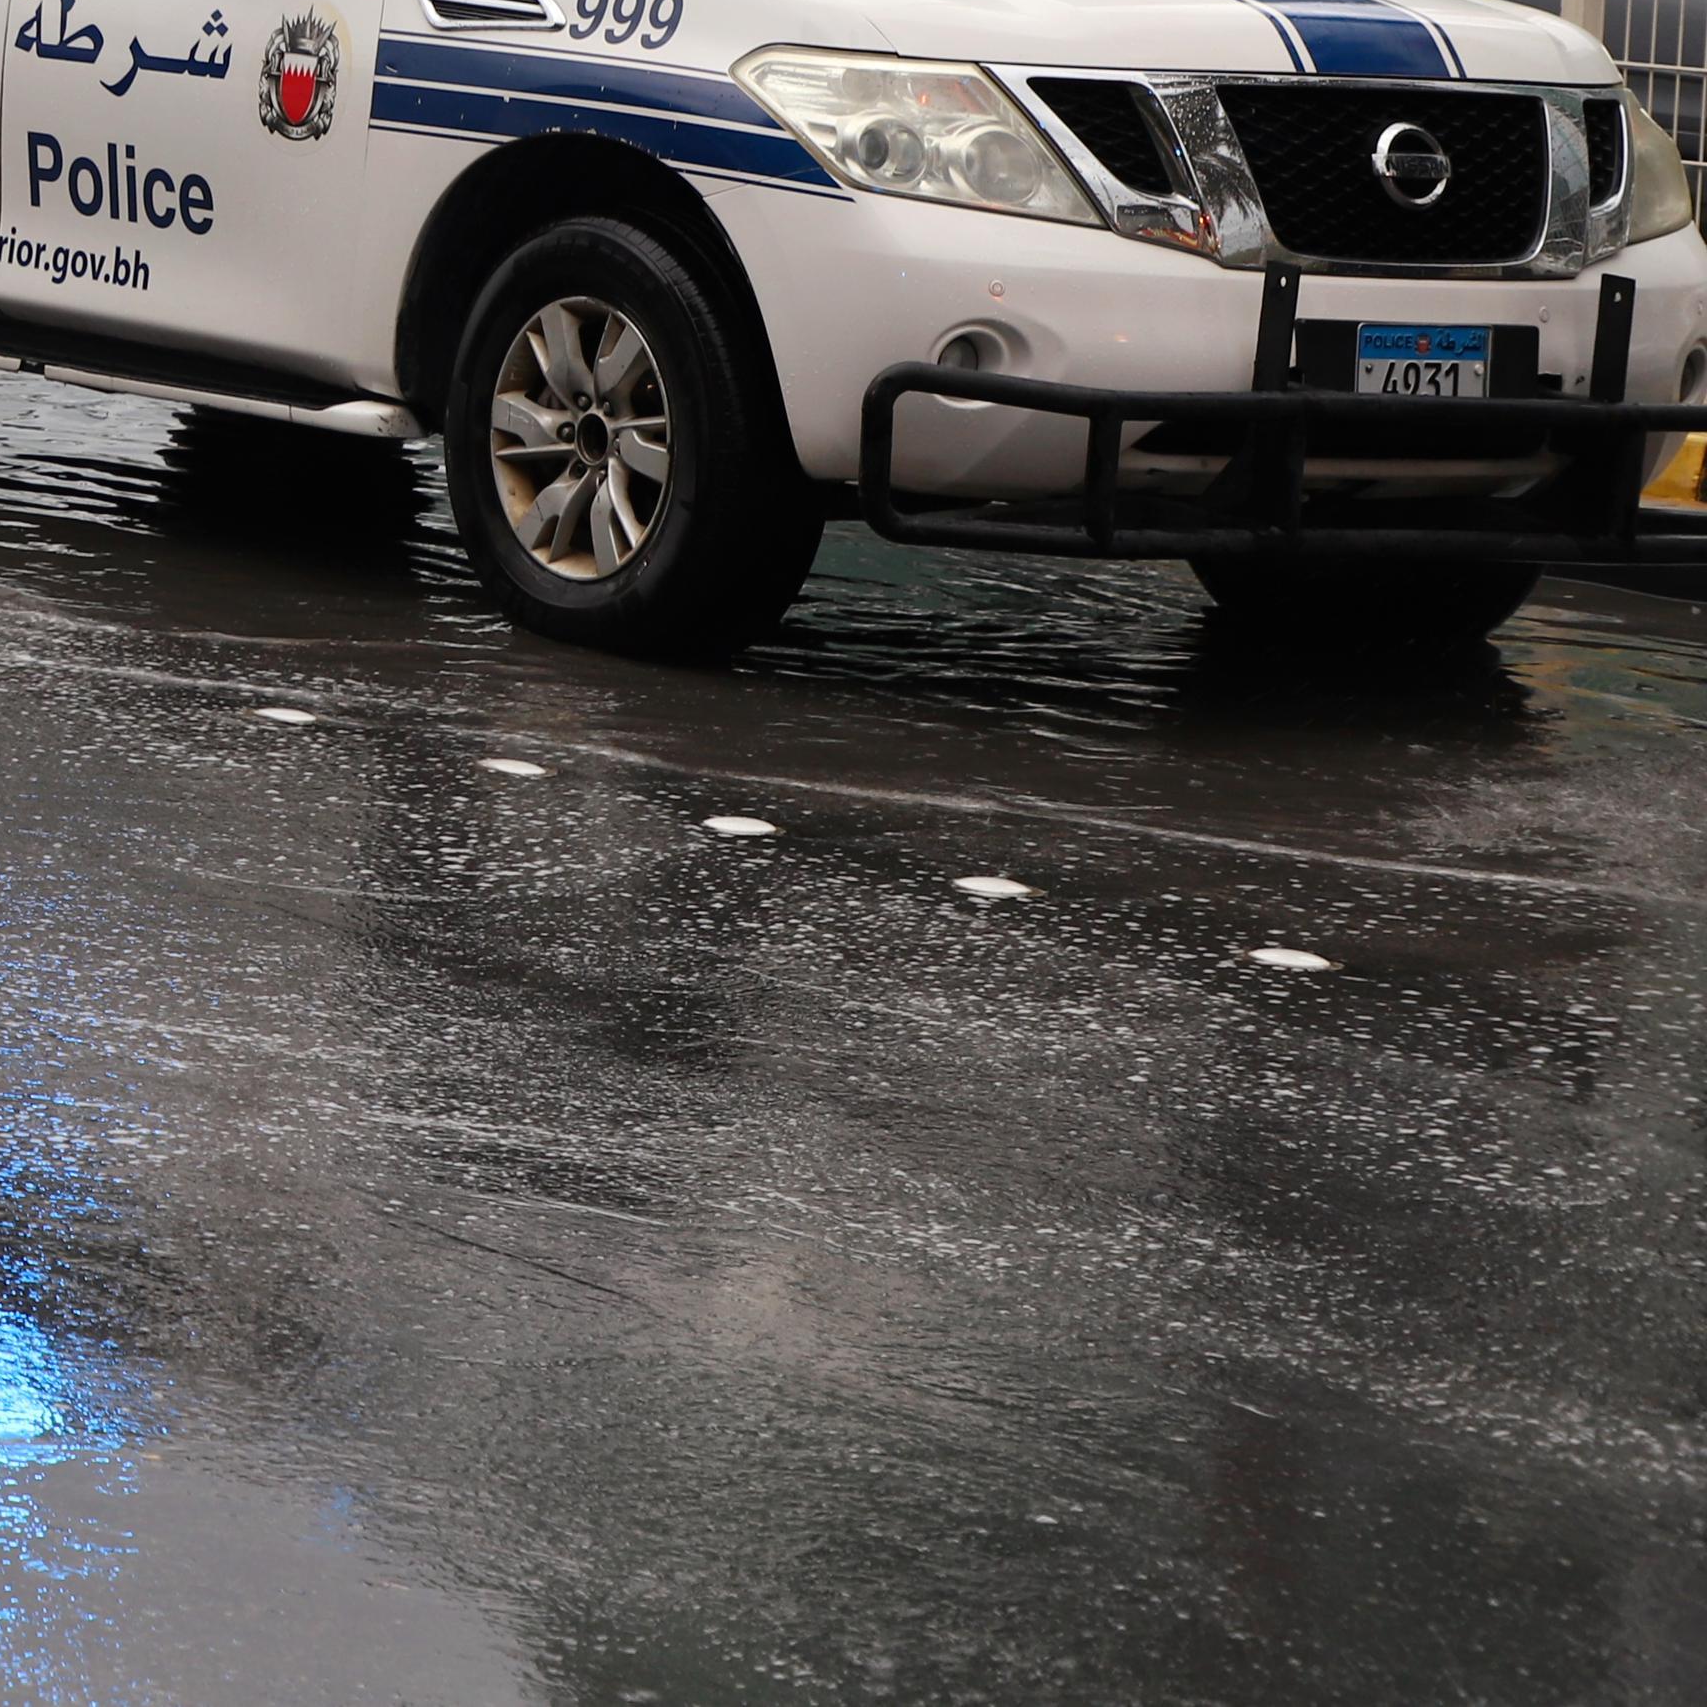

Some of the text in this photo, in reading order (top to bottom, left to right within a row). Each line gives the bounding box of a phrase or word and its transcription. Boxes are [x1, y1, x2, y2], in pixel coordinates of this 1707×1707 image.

[27, 130, 215, 236] Police
[1364, 333, 1413, 349] POLICE
[1382, 361, 1460, 398] 4931
